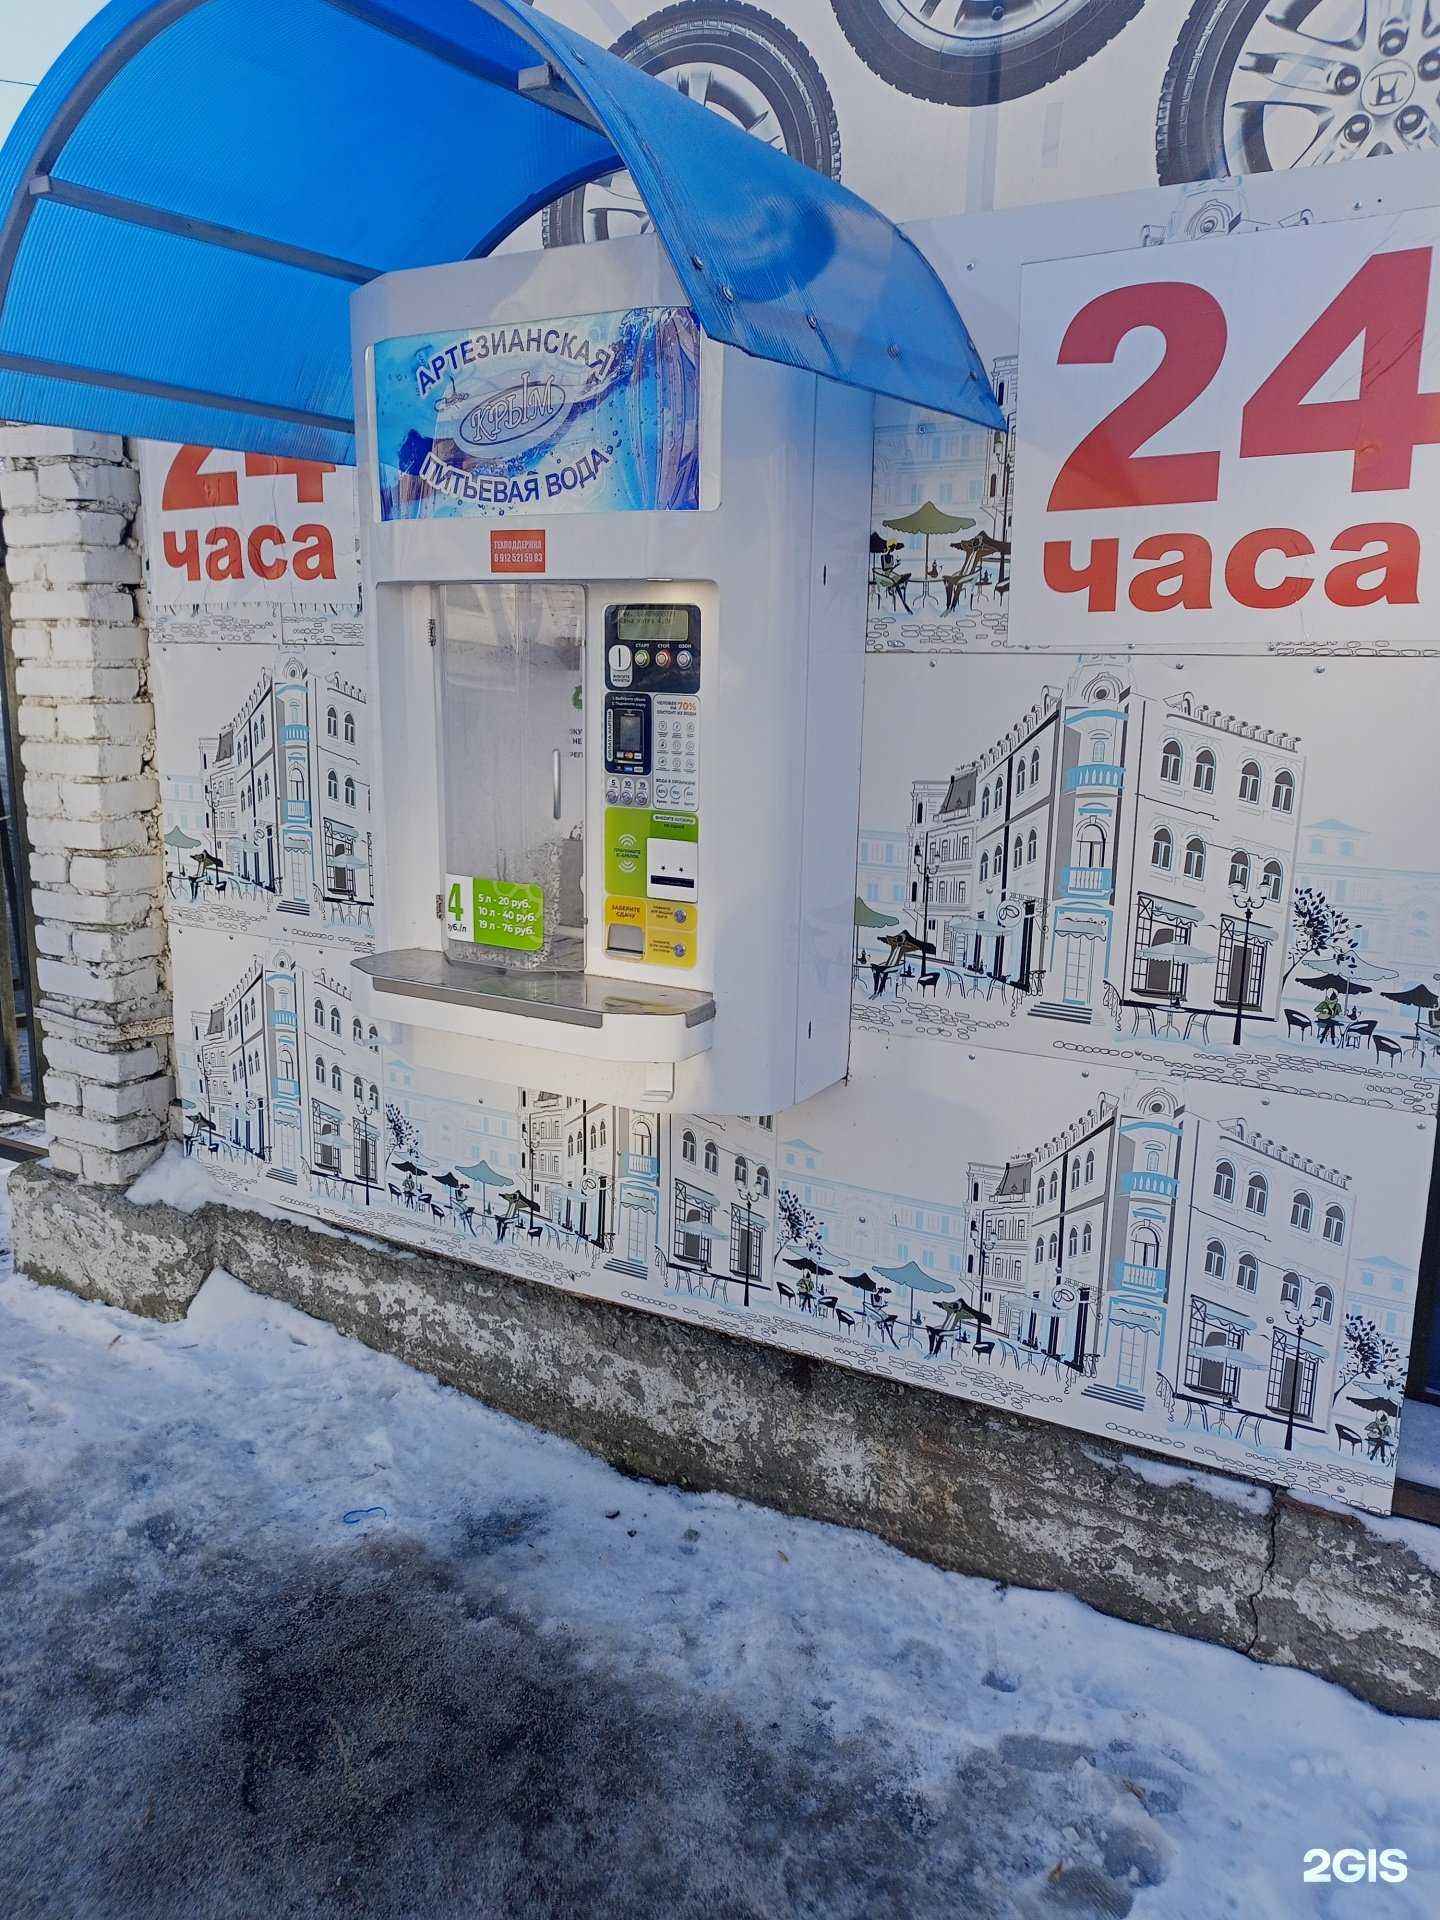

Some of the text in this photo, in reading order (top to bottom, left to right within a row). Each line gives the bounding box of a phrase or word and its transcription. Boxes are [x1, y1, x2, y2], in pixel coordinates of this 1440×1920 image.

[417, 329, 613, 394] АРТЕЗИАНСКАЯ
[1047, 246, 1440, 512] 24
[470, 370, 556, 442] КРЫМ
[421, 448, 608, 503] ПИТЬЕВАЯ ВОДА
[162, 523, 337, 582] часа
[1043, 522, 1421, 613] часа
[677, 702, 697, 711] 70%
[447, 883, 464, 921] 4
[479, 894, 484, 902] 5
[499, 897, 509, 905] 20
[511, 899, 531, 909] руб.
[479, 907, 488, 916] 10
[502, 910, 514, 919] 40
[516, 912, 537, 923] руб.
[480, 920, 488, 929] 19
[489, 922, 496, 930] л
[502, 924, 513, 933] 76
[515, 926, 536, 936] руб.
